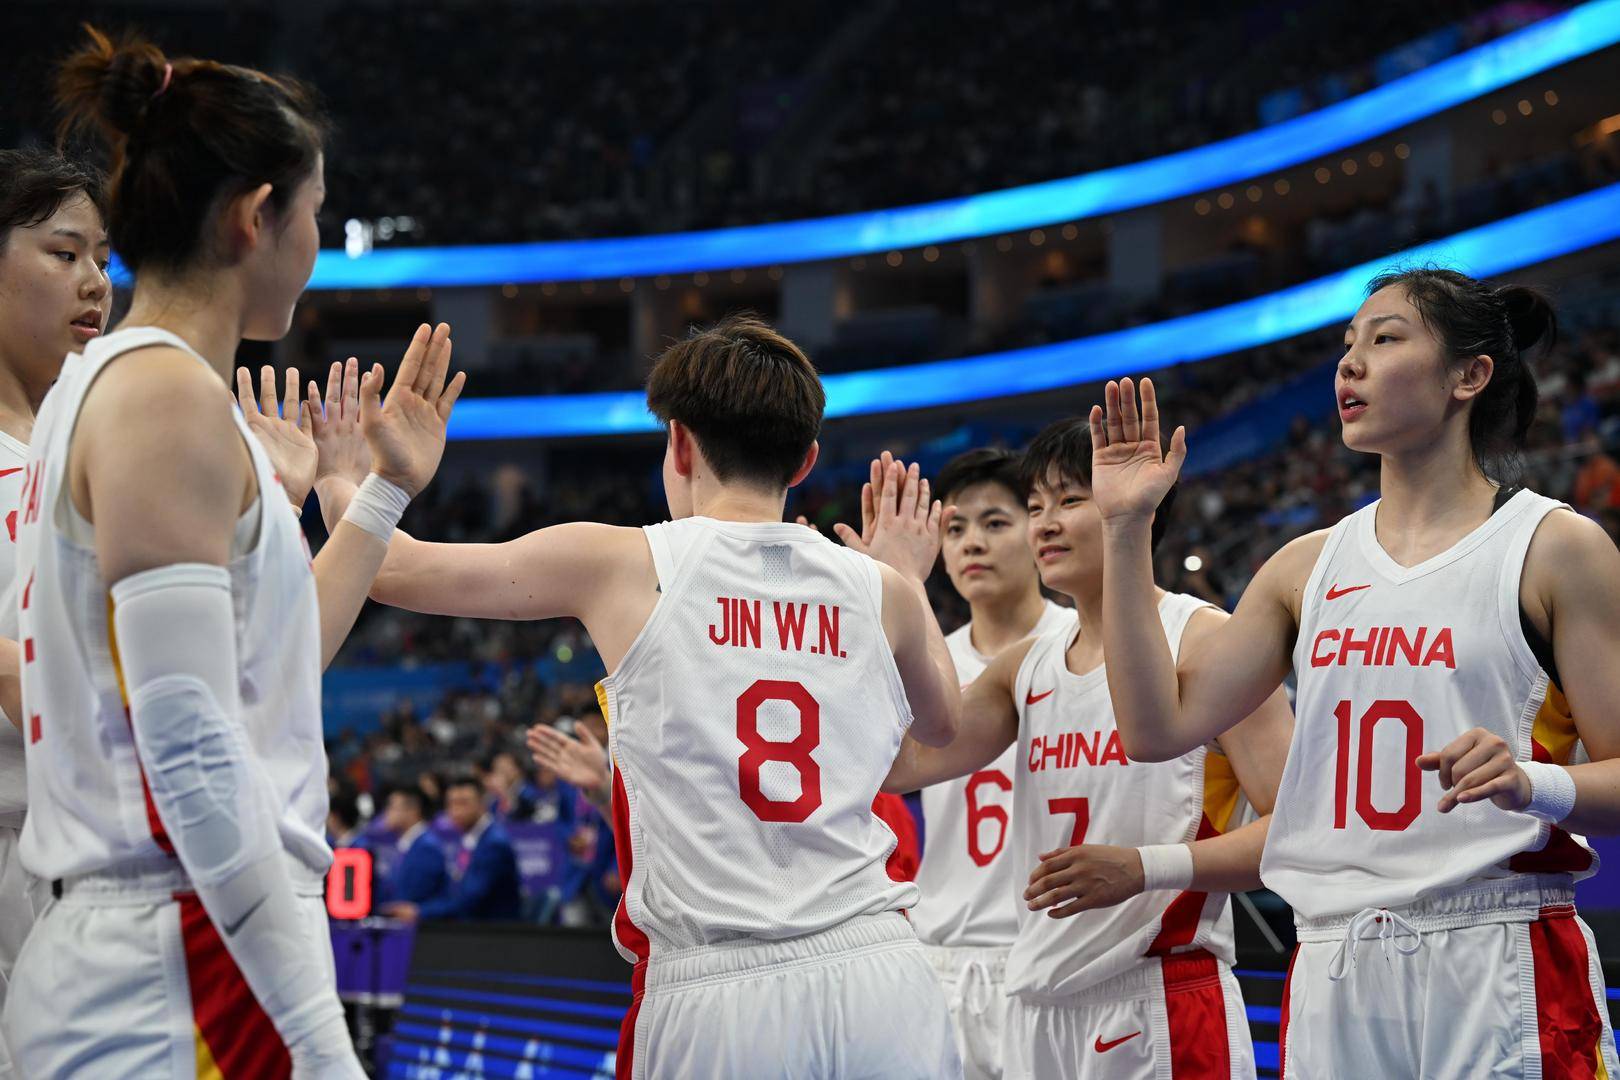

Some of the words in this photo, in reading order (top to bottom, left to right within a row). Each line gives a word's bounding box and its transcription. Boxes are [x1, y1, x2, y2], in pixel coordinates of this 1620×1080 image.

[708, 596, 762, 650] JIN
[773, 601, 847, 659] W.N.
[1311, 626, 1456, 669] CHINA
[735, 679, 822, 823] 8
[1028, 729, 1129, 773] CHINA
[1333, 700, 1425, 832] 10
[964, 769, 1013, 868] 6
[1047, 796, 1090, 849] 7
